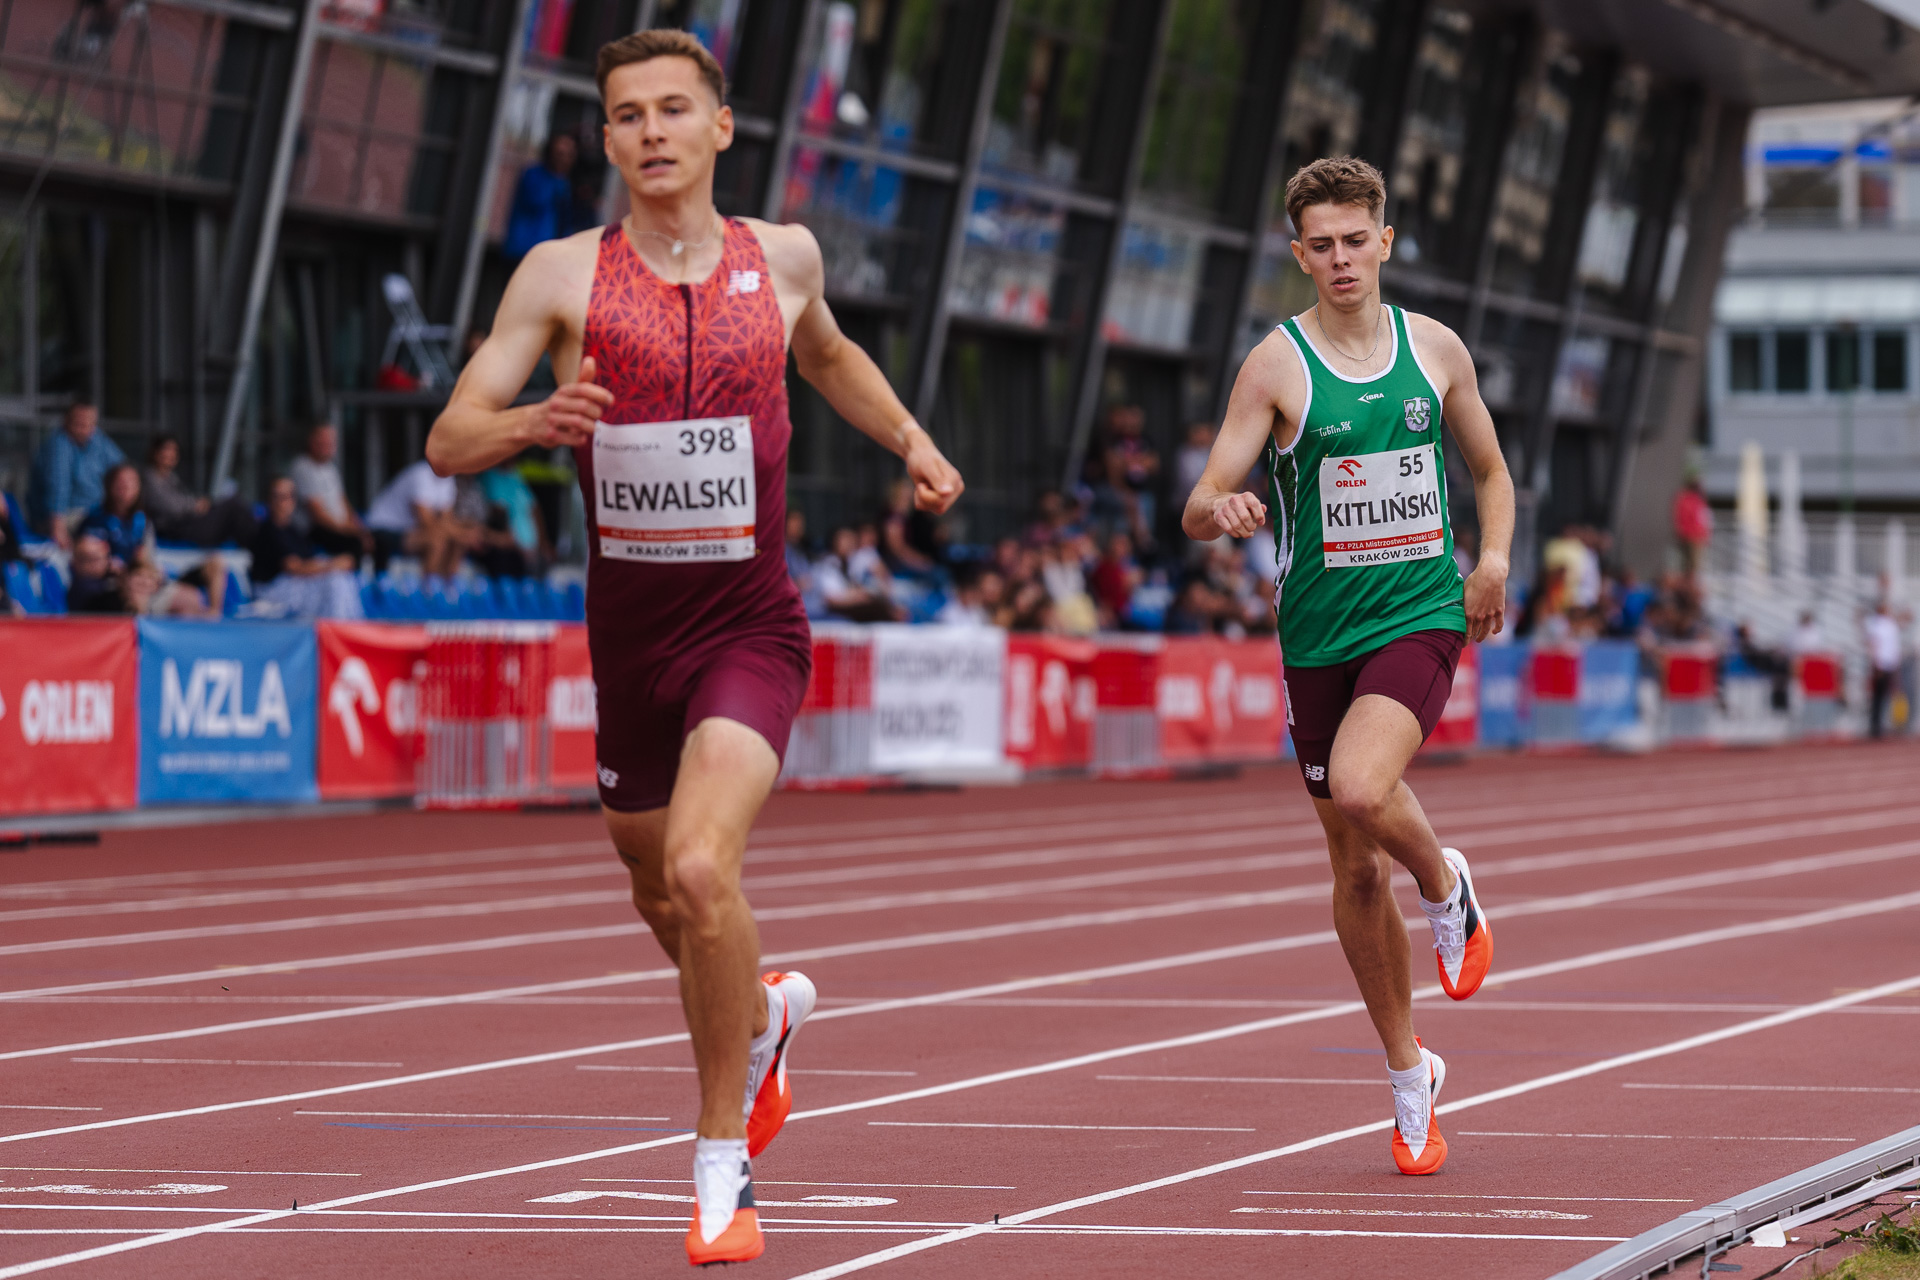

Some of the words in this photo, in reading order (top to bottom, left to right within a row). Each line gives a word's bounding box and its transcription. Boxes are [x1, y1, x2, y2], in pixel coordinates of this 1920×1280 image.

[680, 427, 736, 455] 398
[1399, 453, 1424, 477] 55
[602, 477, 747, 511] LEWALSKI
[1335, 479, 1367, 488] ORLEN
[1326, 490, 1439, 527] KITLIŃSKI
[627, 540, 689, 557] KRAKÓW
[693, 543, 728, 557] 2025
[1347, 542, 1364, 550] PZLA
[1365, 538, 1407, 549] Mistrzostwa
[1408, 534, 1428, 543] Polski
[1428, 531, 1439, 540] U23
[1350, 549, 1401, 563] KRAKÓW
[1403, 545, 1430, 558] 2025
[158, 656, 292, 739] MZLA
[20, 679, 115, 746] ORLEN
